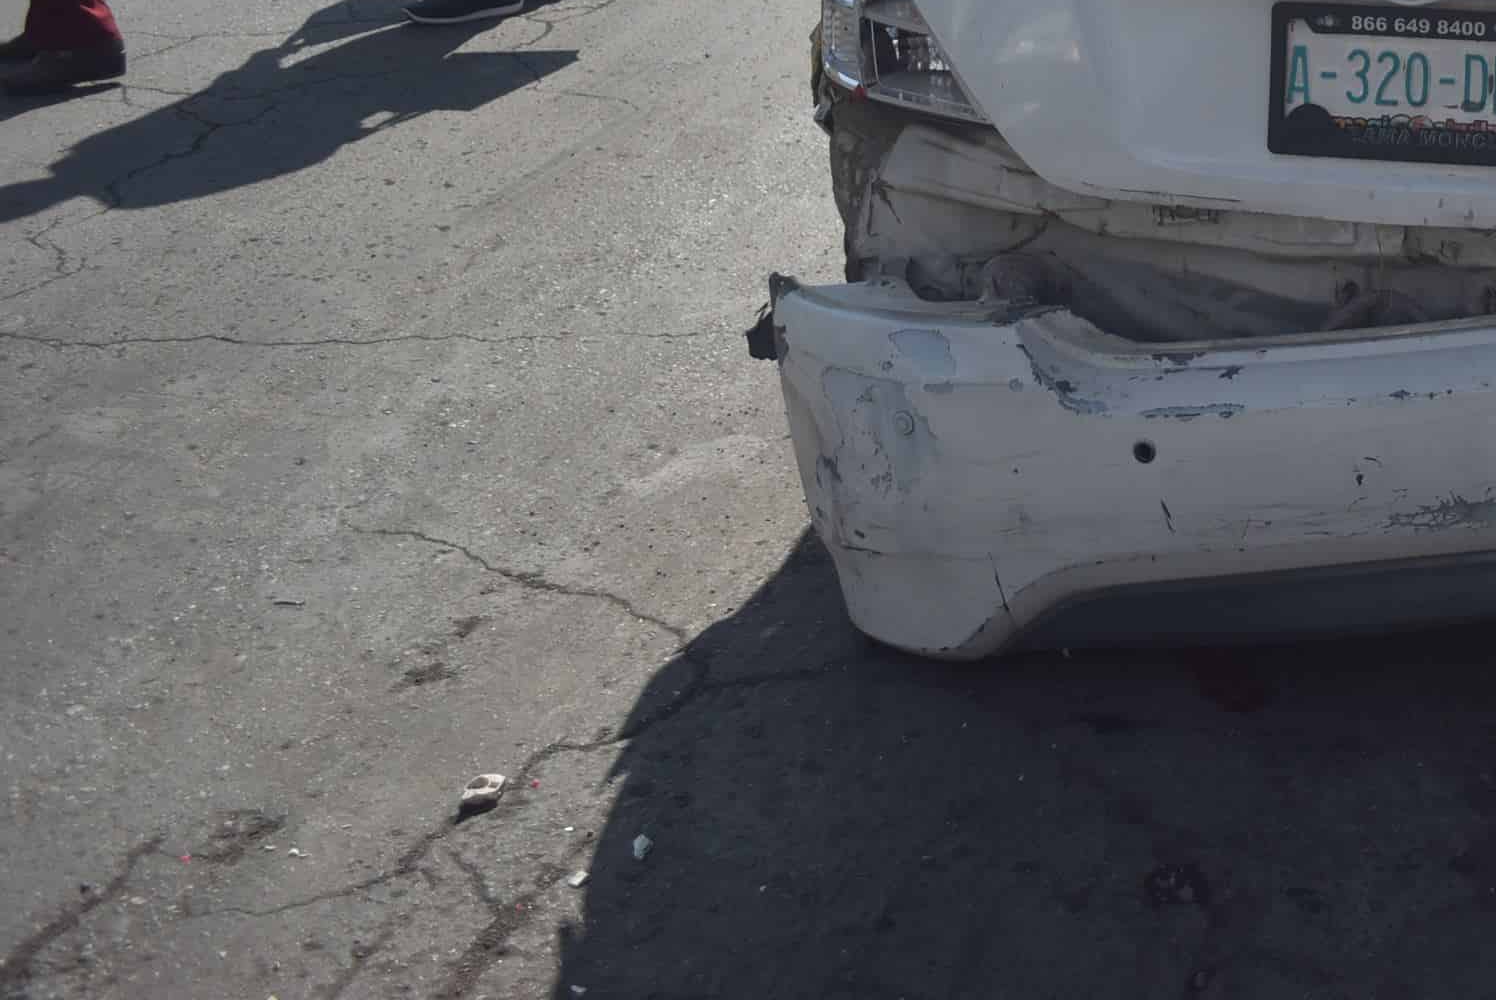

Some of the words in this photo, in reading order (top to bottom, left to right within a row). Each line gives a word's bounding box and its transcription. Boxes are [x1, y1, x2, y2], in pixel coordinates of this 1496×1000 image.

[1351, 15, 1388, 32] 866
[1393, 18, 1431, 34] 649
[1437, 19, 1486, 37] 8400
